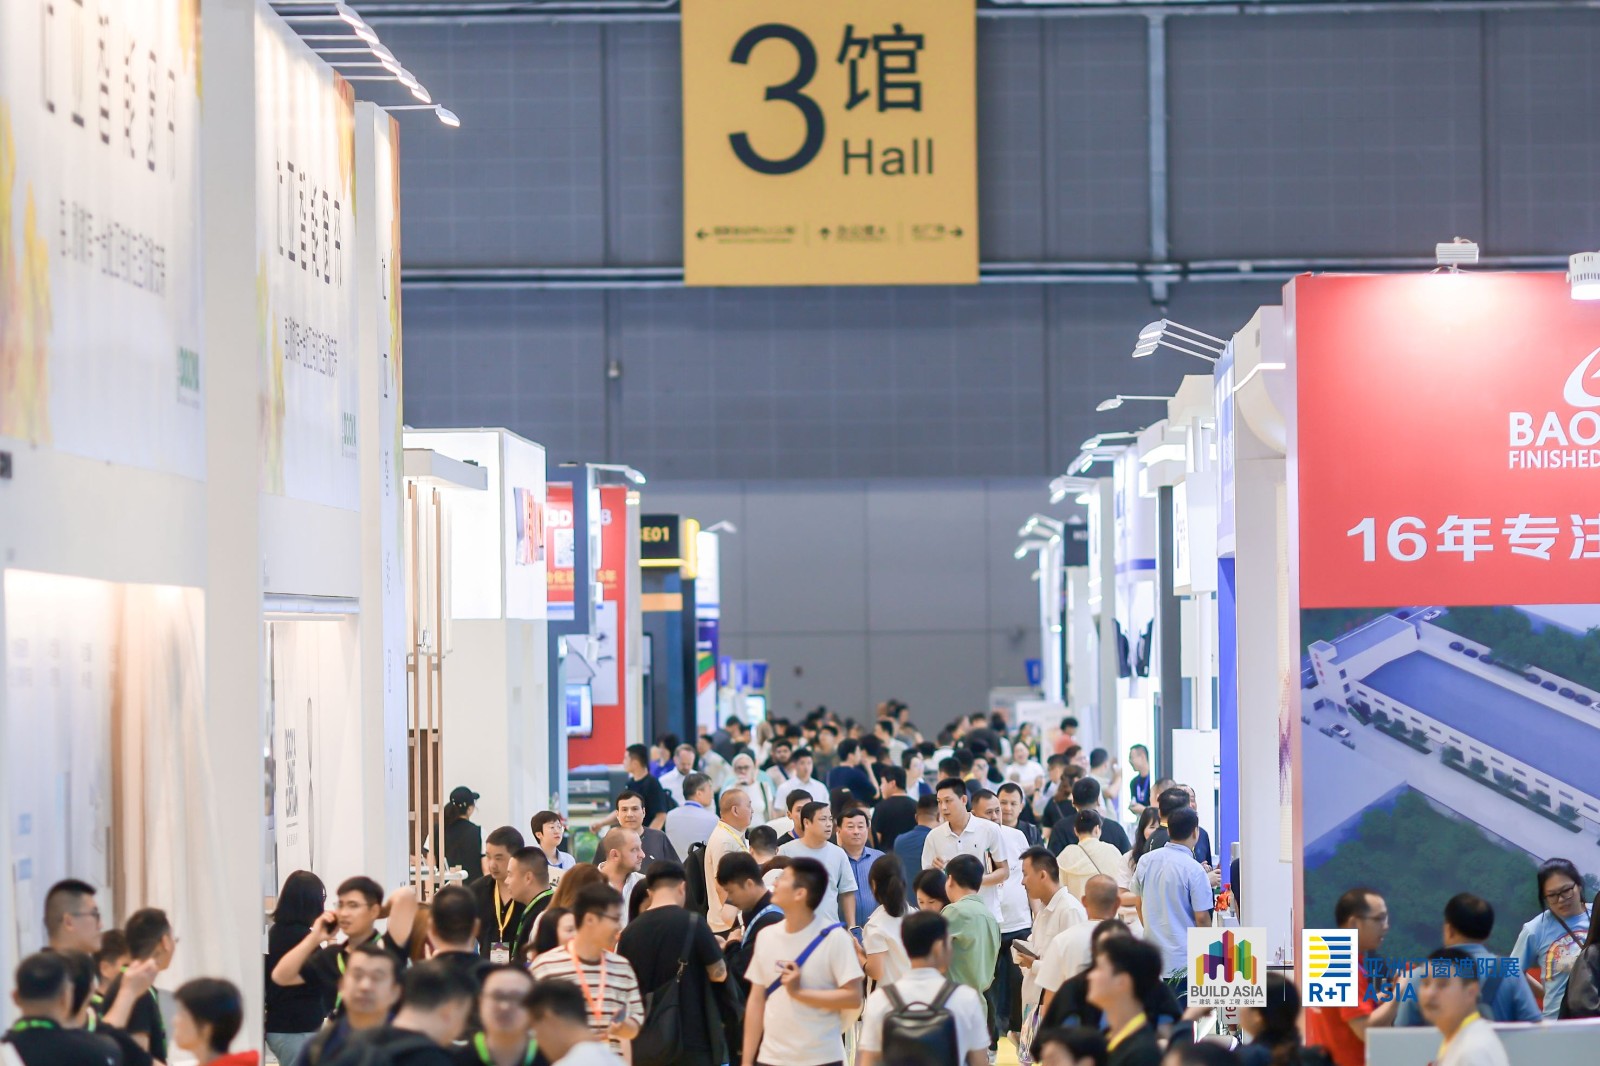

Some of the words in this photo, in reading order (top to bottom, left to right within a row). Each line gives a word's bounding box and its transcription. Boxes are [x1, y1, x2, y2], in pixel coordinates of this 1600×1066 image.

[728, 23, 825, 175] 3
[836, 23, 924, 112] 馆
[842, 138, 933, 175] Hall
[1509, 450, 1600, 469] FINISHED
[640, 526, 670, 542] E01
